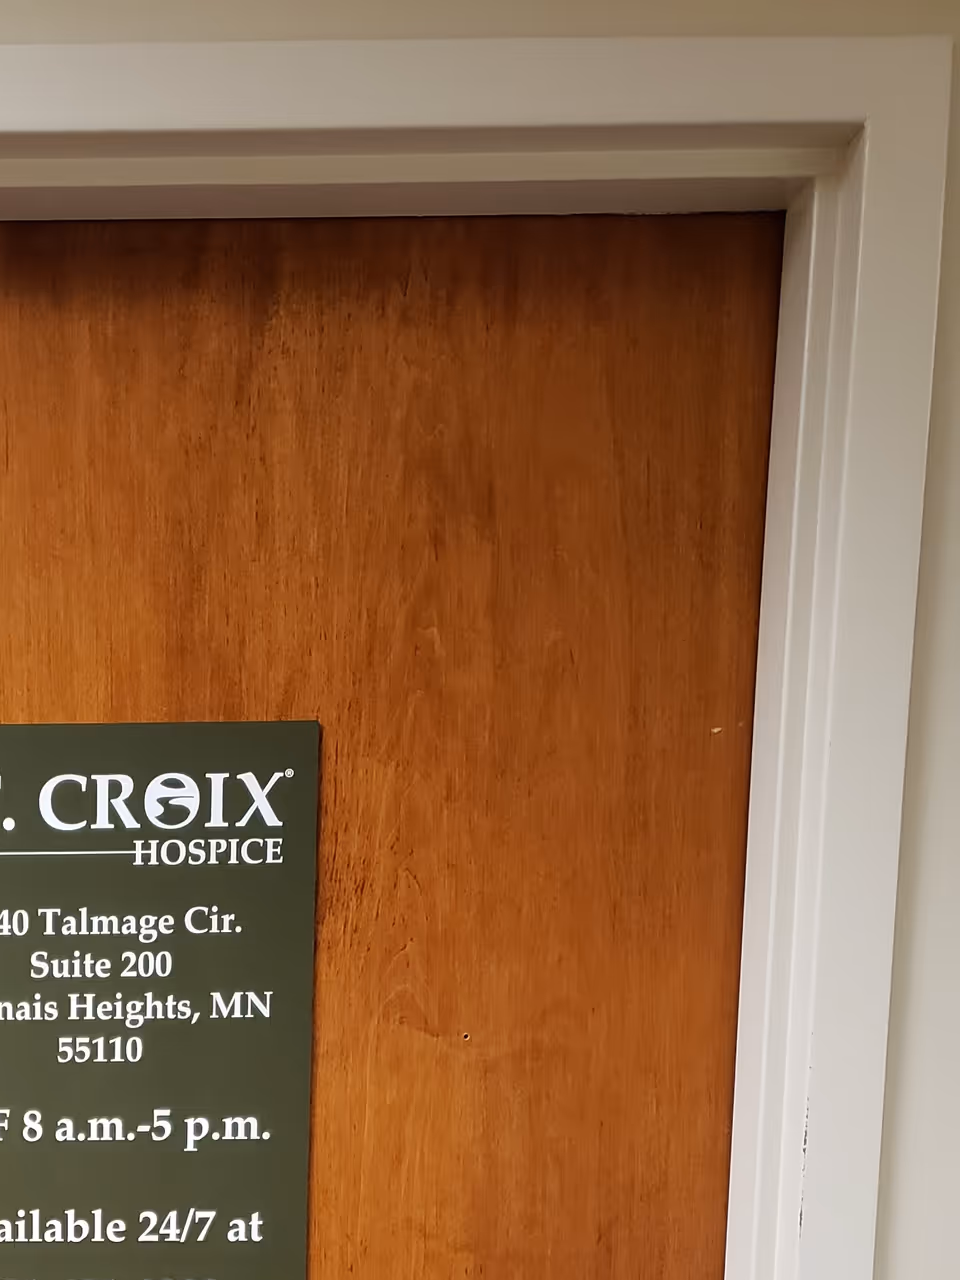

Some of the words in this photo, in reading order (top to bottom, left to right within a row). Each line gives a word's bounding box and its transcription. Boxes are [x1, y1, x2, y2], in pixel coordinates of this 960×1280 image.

[133, 837, 284, 866] HOSPICE
[37, 906, 175, 944] Talmage
[184, 905, 243, 934] Cir.
[30, 950, 112, 979] Suite
[119, 950, 173, 978] 200
[67, 991, 201, 1029] Heights,
[209, 990, 274, 1019] MN
[56, 1035, 144, 1064] 55110
[22, 1109, 44, 1143] 8
[54, 1108, 172, 1143] a.m.-5
[183, 1116, 271, 1152] p.m.
[137, 1207, 217, 1243] 24/7
[226, 1211, 264, 1243] at
